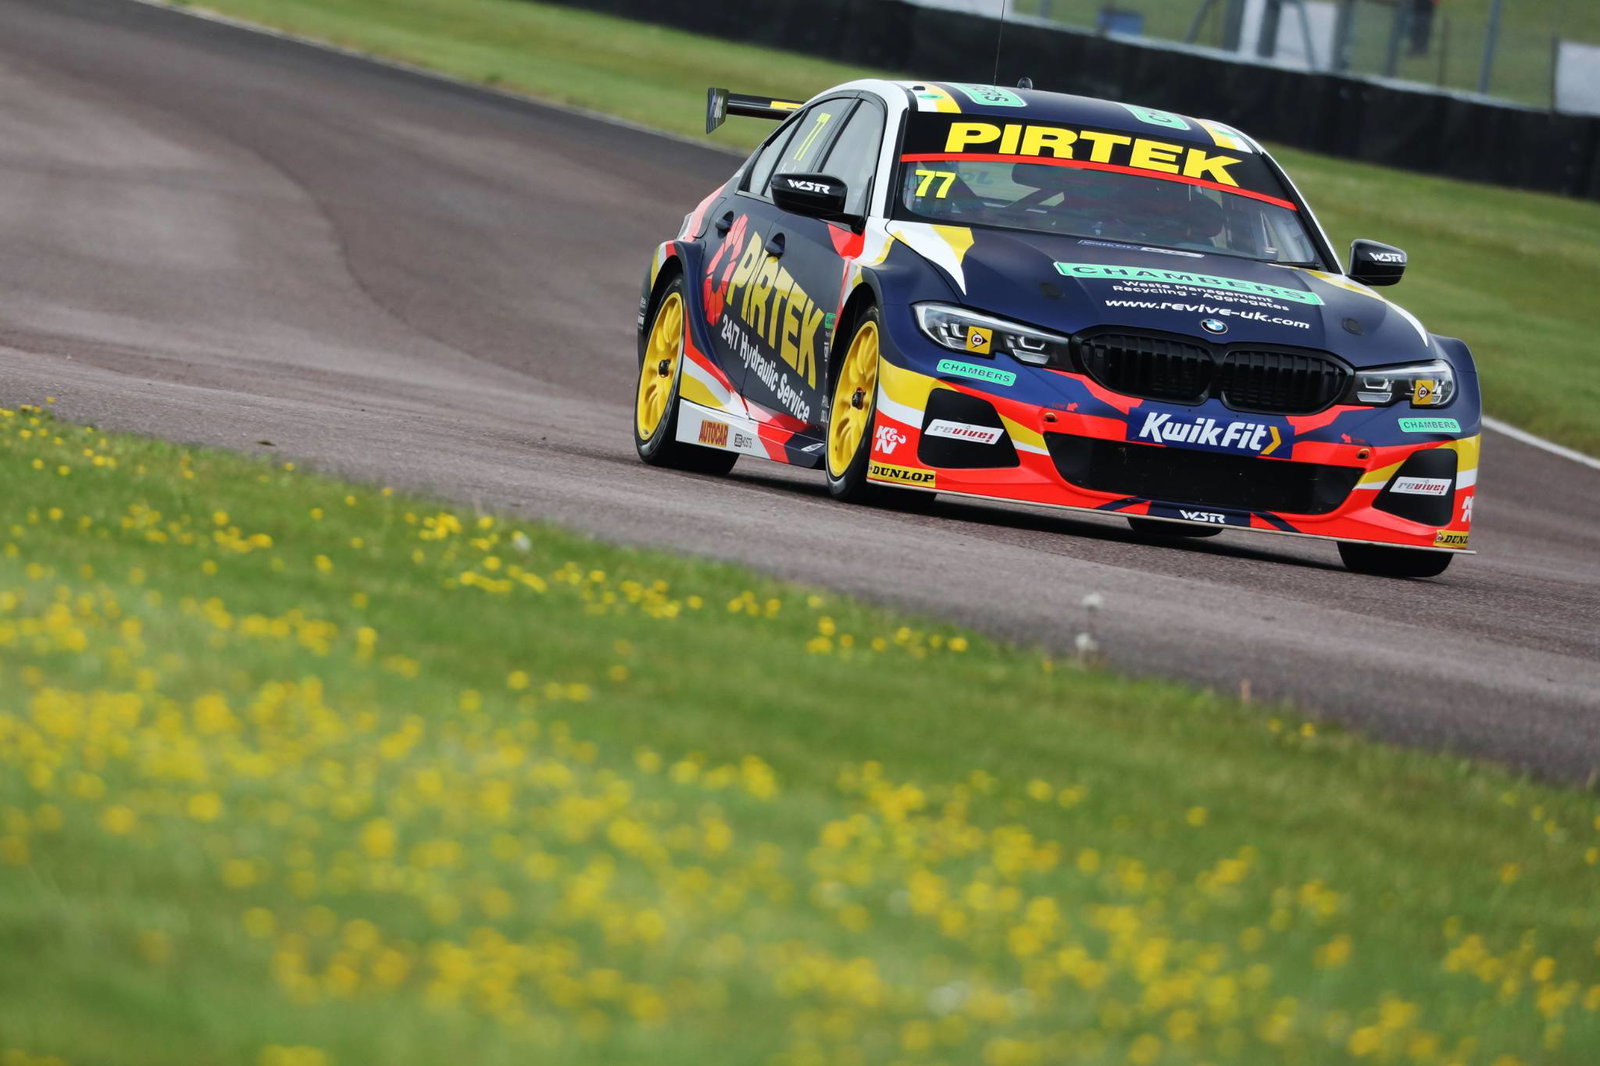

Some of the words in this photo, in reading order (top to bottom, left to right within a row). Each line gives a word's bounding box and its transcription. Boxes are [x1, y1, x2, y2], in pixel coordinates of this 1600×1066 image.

[944, 122, 1243, 187] PIRTEK
[787, 179, 831, 194] WSR
[915, 169, 956, 199] 77
[1369, 252, 1403, 262] WSR
[1073, 266, 1306, 299] CHAMBERS
[1122, 280, 1171, 289] Waste
[1175, 284, 1273, 303] Management
[725, 231, 825, 390] PIRTEK
[1112, 285, 1188, 297] Recycling
[1202, 292, 1290, 311] Aggregates
[1105, 300, 1310, 329] www.revive-uk.com
[721, 313, 740, 350] 24/7
[740, 331, 779, 393] Hydraulic
[776, 373, 811, 424] Service
[942, 362, 1011, 383] CHAMBERS
[700, 420, 729, 447] AUTOCAR
[1403, 420, 1457, 429] CHAMBERS
[872, 465, 935, 482] DUNLOP
[1179, 509, 1225, 524] WSR
